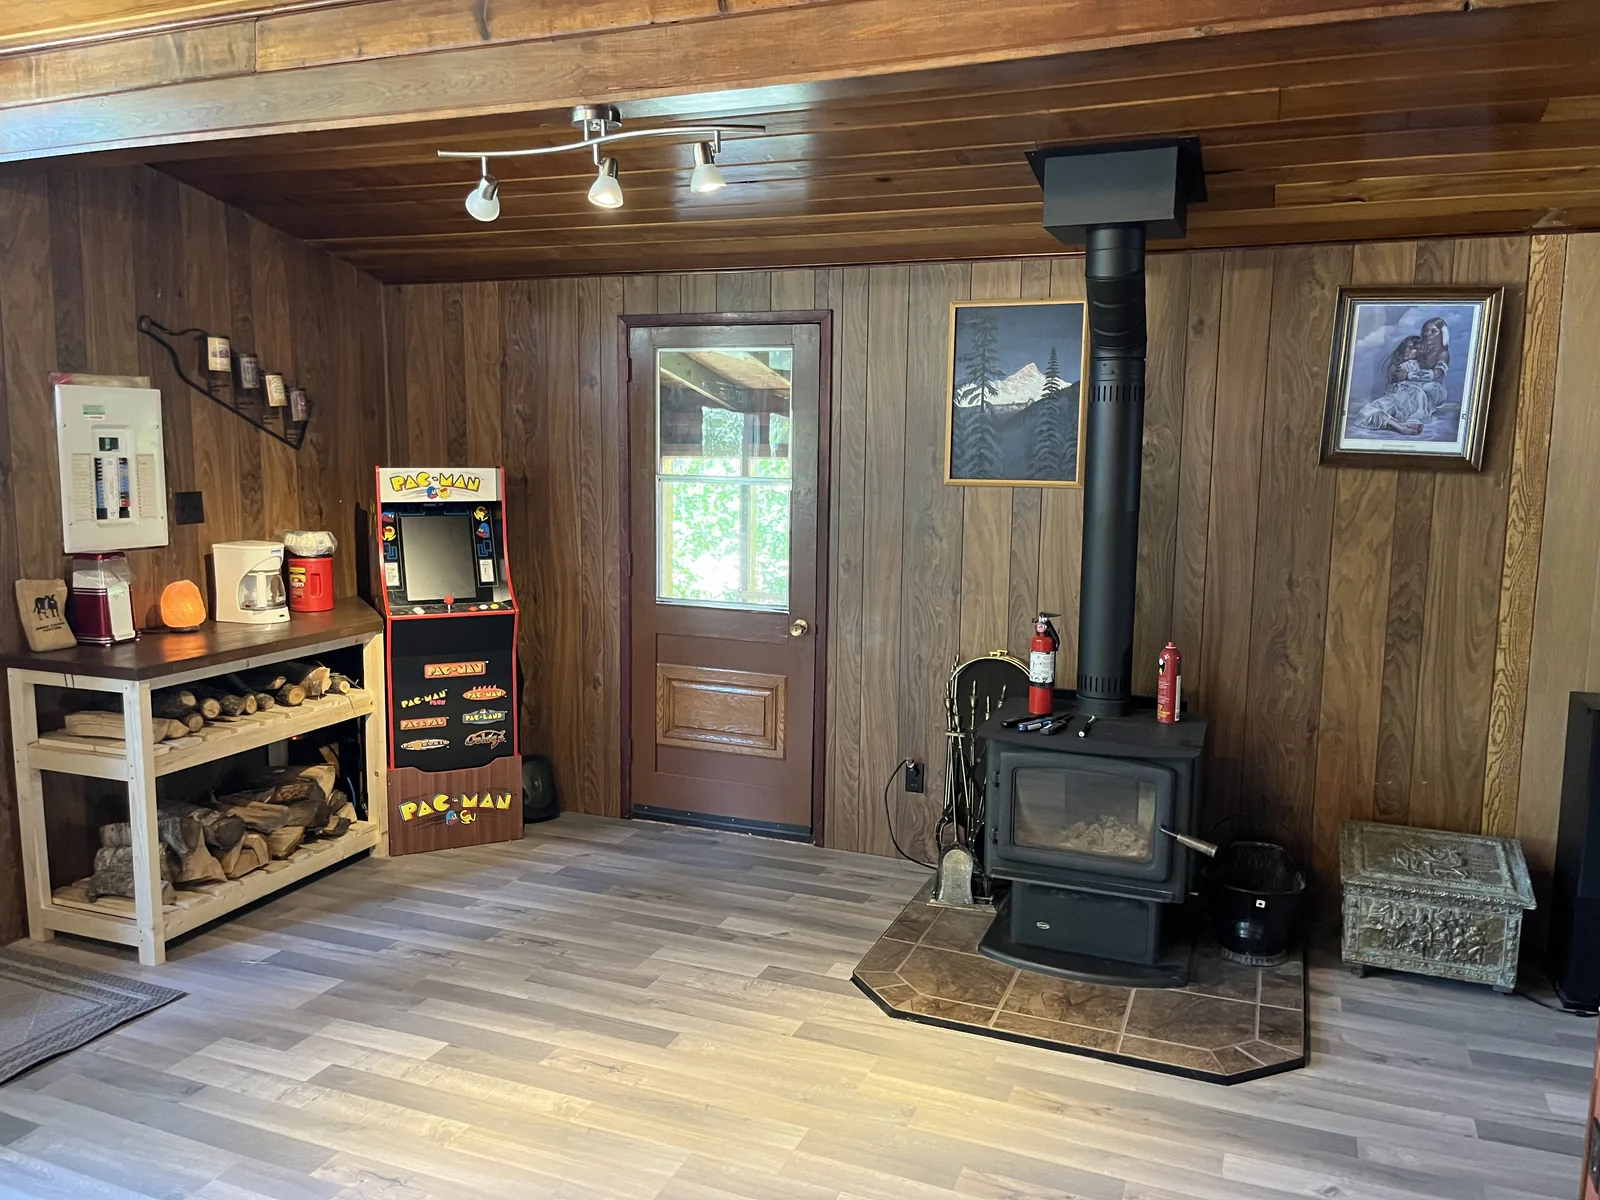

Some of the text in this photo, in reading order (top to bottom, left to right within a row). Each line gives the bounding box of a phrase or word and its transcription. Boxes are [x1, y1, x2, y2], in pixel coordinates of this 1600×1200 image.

[390, 471, 481, 492] PAC-MAN
[427, 663, 484, 676] PAC-MAN
[401, 690, 446, 708] PAC-MAN
[467, 690, 503, 699] PAC-MAN
[398, 792, 512, 822] PAC-MAN
